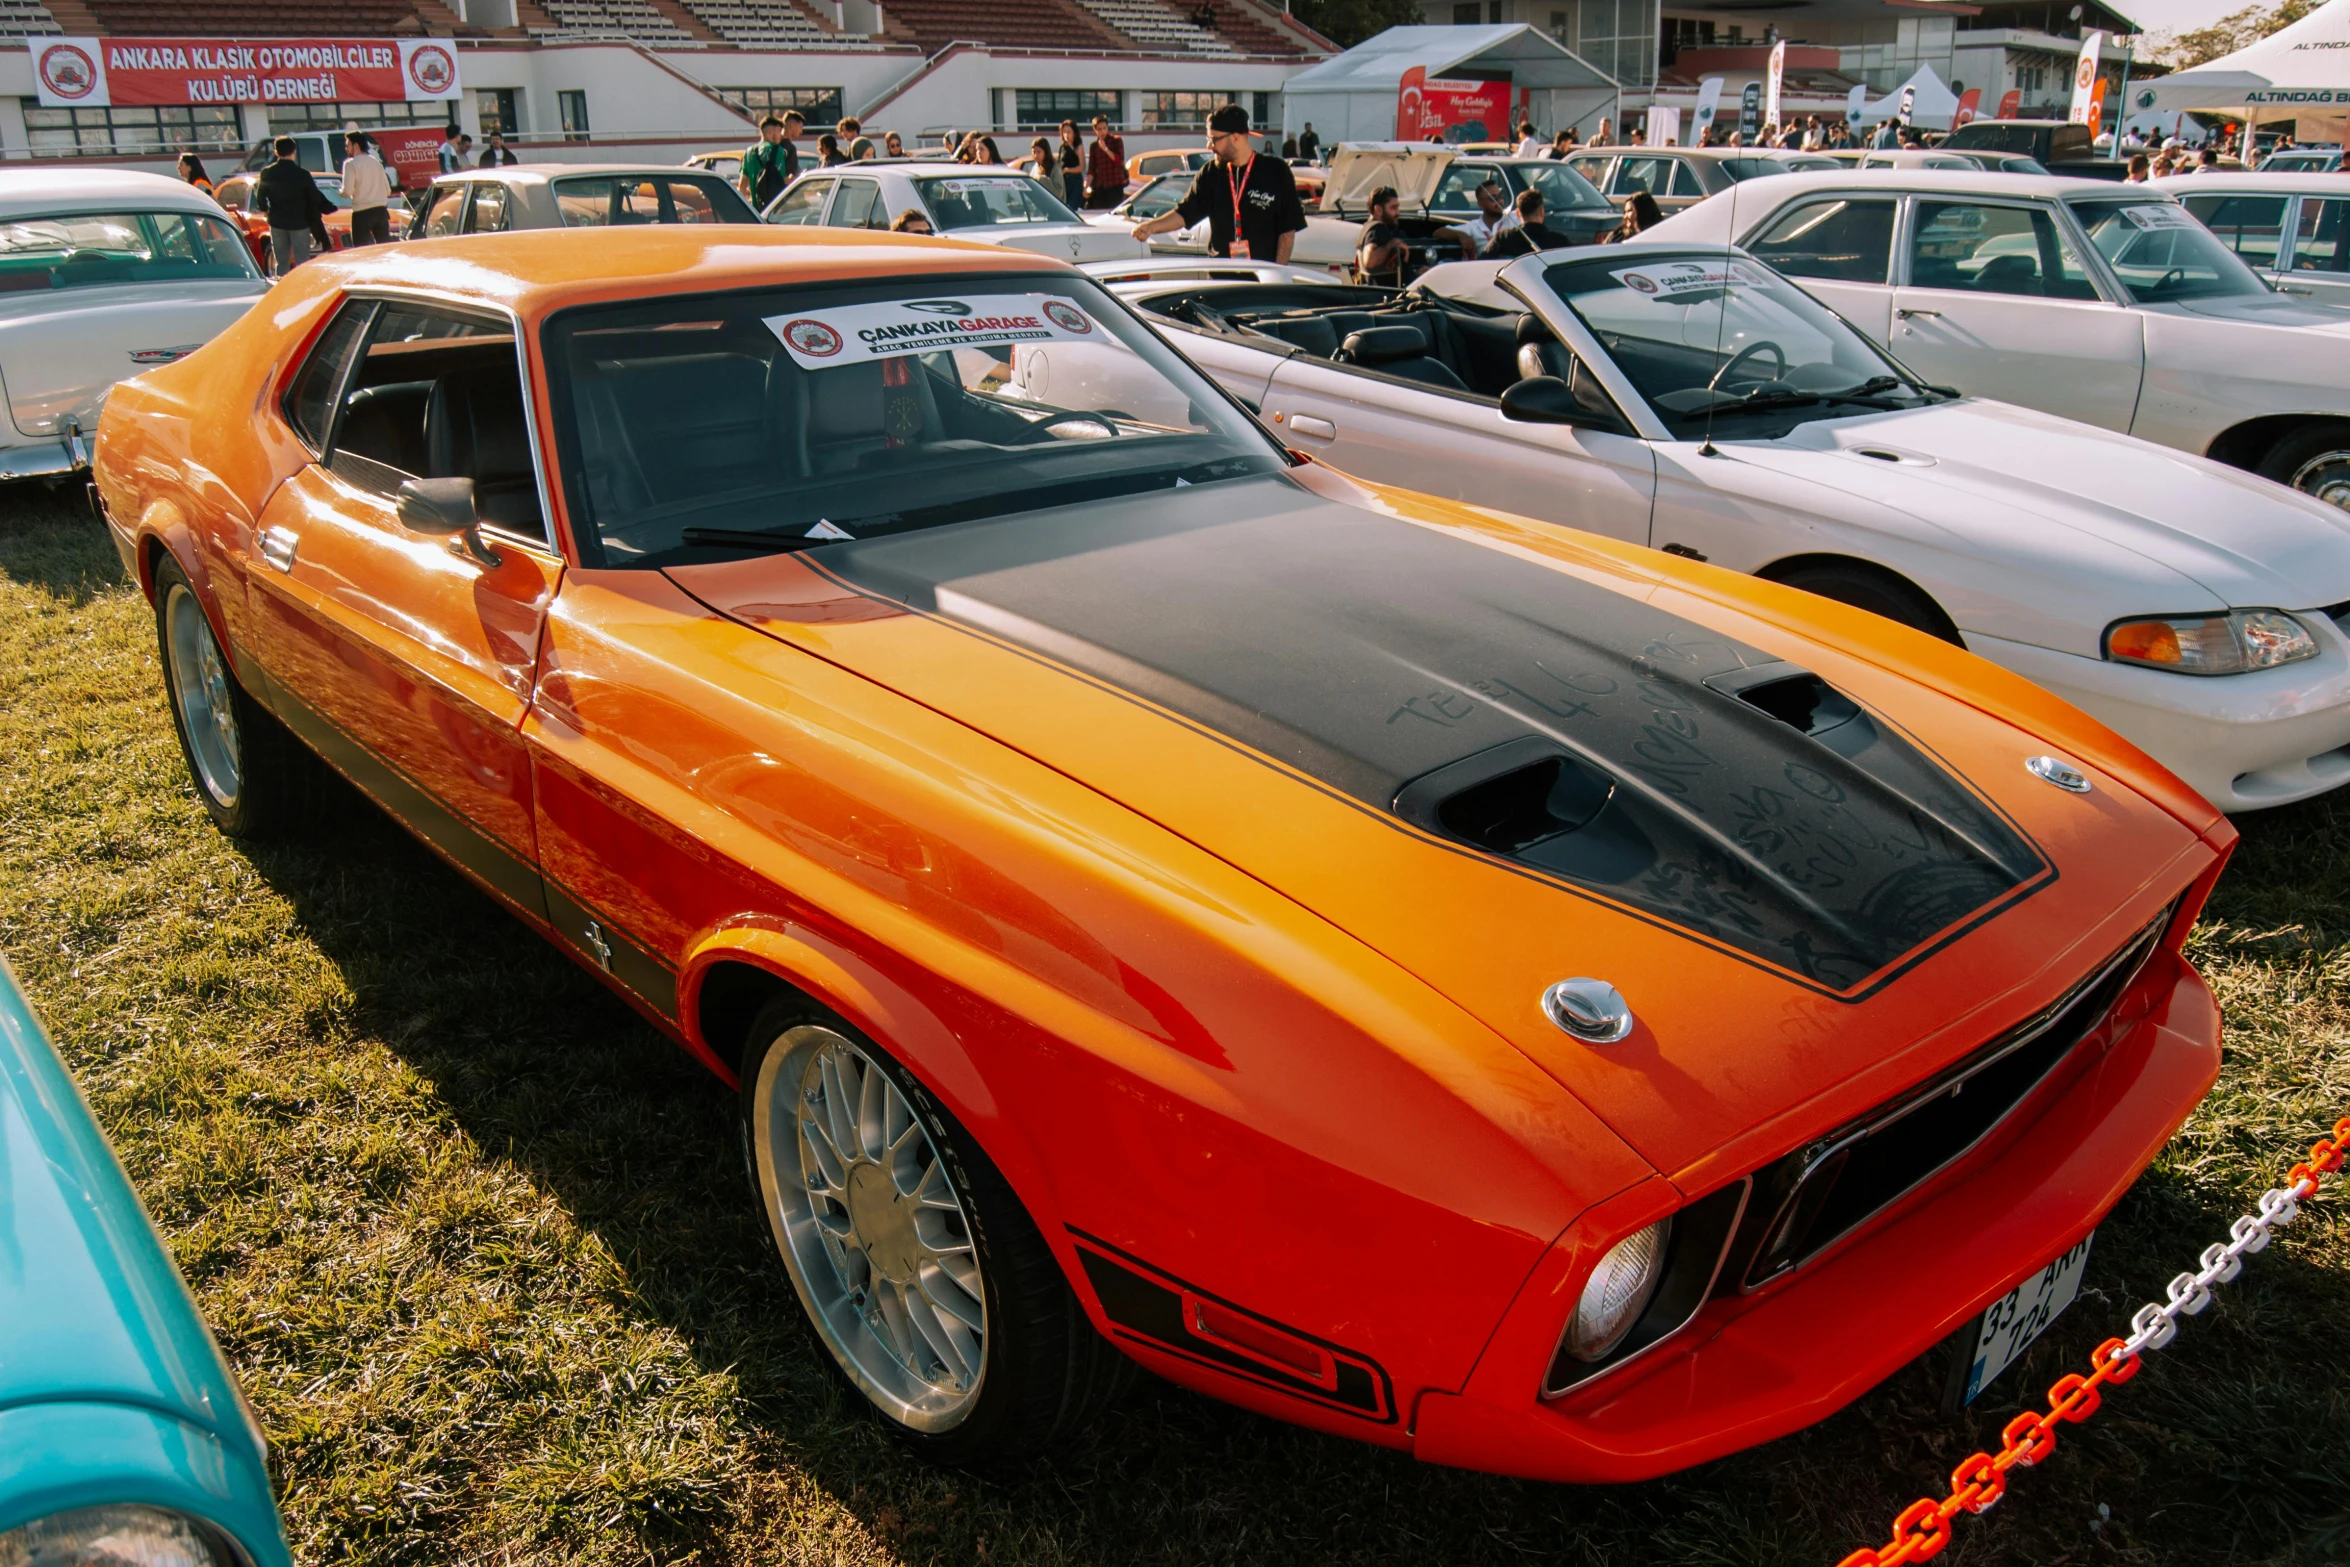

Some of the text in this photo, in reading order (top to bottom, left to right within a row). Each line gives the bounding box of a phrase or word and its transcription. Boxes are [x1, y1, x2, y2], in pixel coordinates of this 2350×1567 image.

[110, 43, 395, 70] ANKARA KLASİK OTOMOBİLCİLER
[187, 73, 338, 102] KULÜBÜ DERNEĞİ
[2245, 90, 2332, 102] ALTINDAĞ
[876, 344, 903, 352] ARAÇ
[904, 338, 953, 348] YENİLEME
[970, 334, 1006, 342] KORUMA
[1983, 1286, 2020, 1346] 33
[2004, 1288, 2054, 1365] 724
